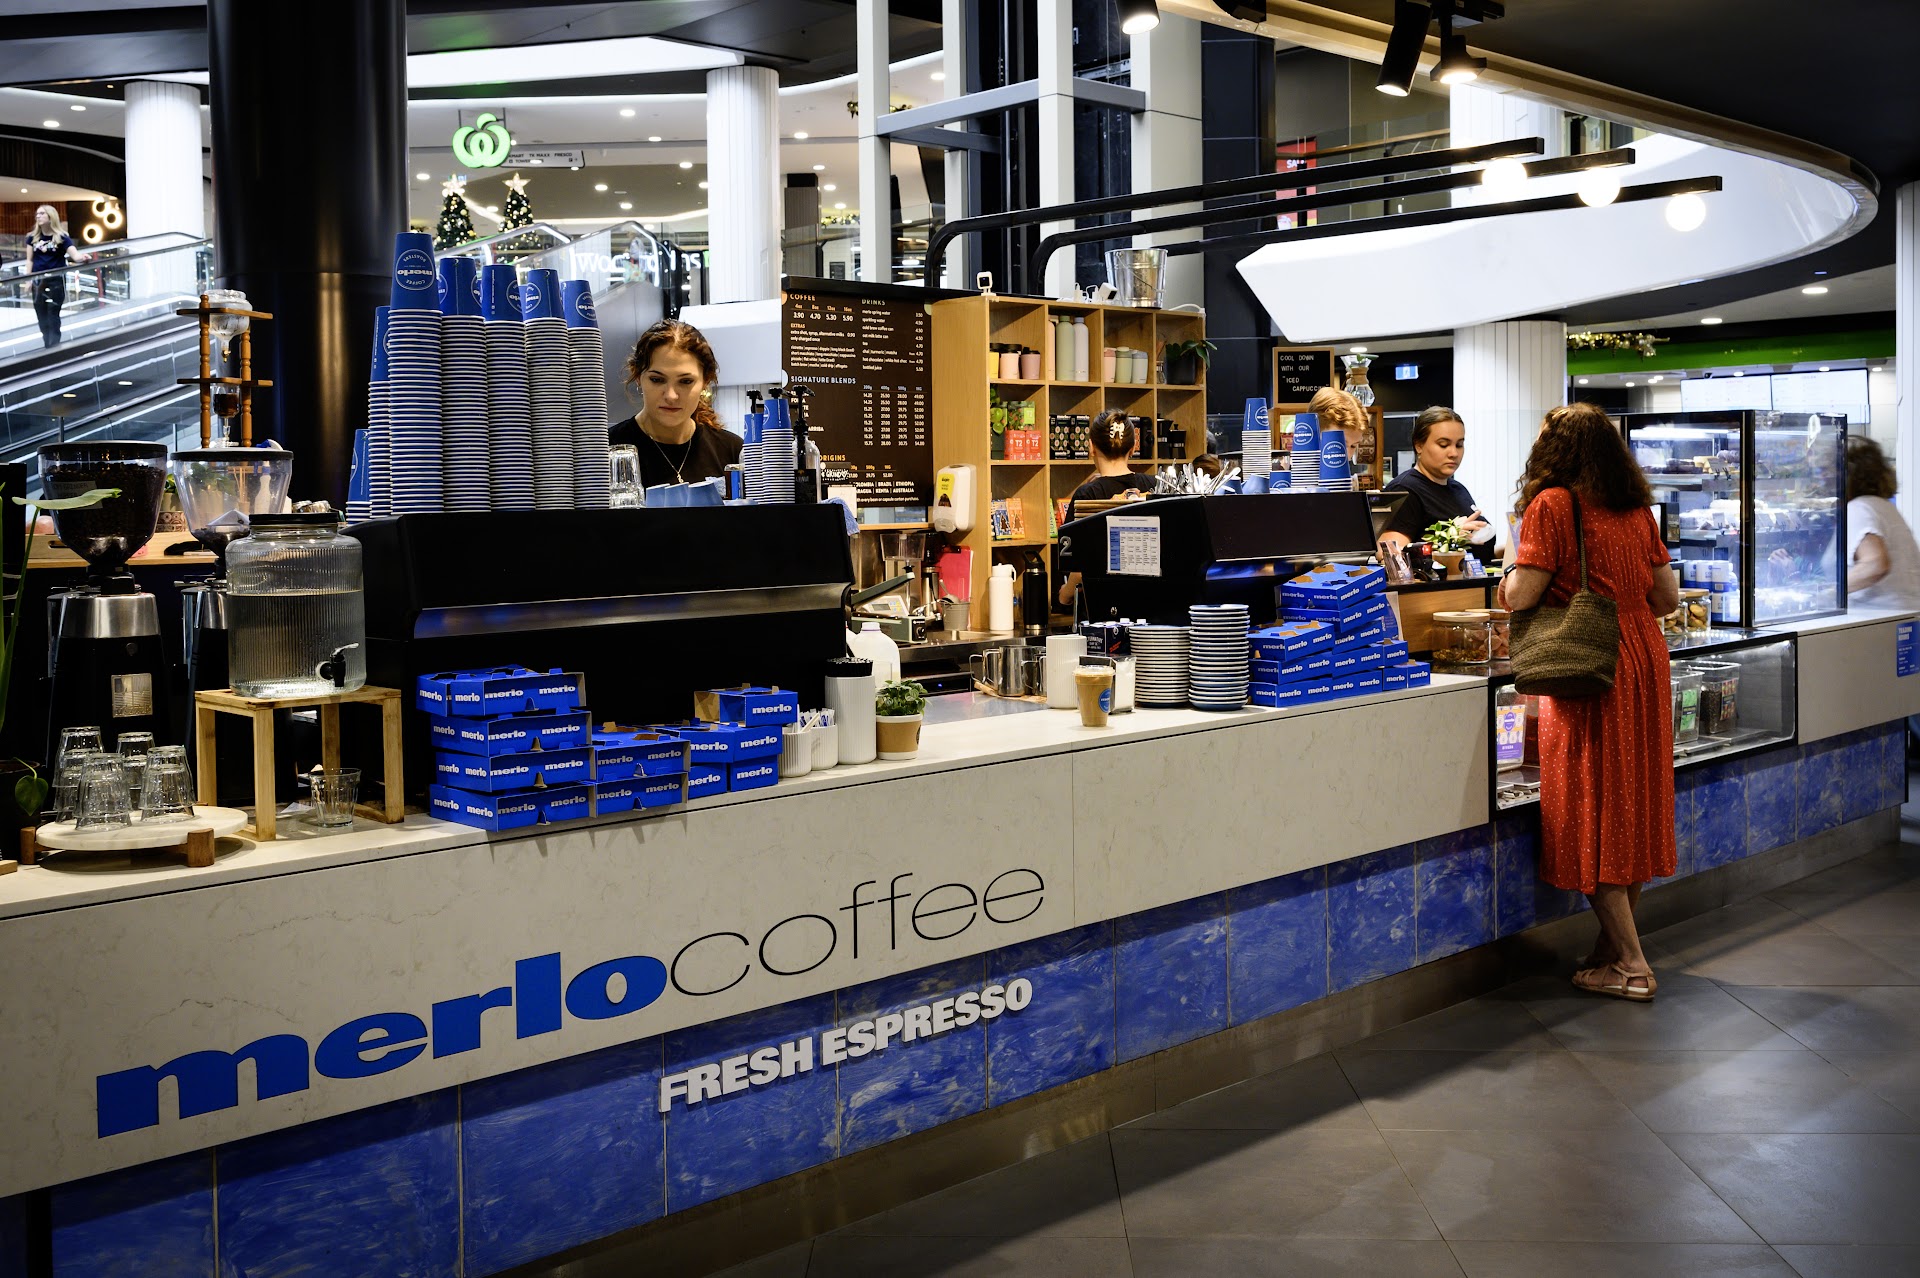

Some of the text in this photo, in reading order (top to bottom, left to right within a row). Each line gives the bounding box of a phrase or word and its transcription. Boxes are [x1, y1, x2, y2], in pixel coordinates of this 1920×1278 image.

[1060, 536, 1072, 556] 2
[1341, 576, 1383, 600] merlo merlo
[1343, 602, 1385, 623] merlo merlo
[1288, 633, 1332, 651] merlo merlo
[1334, 627, 1380, 644] merlo merlo
[1335, 652, 1381, 668] merlo merlo
[1387, 649, 1406, 659] merlo
[1282, 659, 1330, 674] merlo merlo
[1386, 674, 1405, 682] merlo
[1410, 670, 1428, 679] merlo
[484, 685, 576, 698] merlo merlo
[1279, 686, 1330, 698] merlo merlo
[1333, 678, 1380, 691] merlo merlo
[420, 689, 442, 701] merlo
[455, 693, 480, 702] merlo
[752, 704, 792, 714] merlo
[433, 725, 484, 741] merlo merlo
[488, 724, 580, 740] merlo merlo
[740, 735, 778, 748] merlo
[598, 750, 682, 765] merlo merlo
[438, 764, 487, 777] merlo merlo
[490, 759, 584, 776] merlo merlo
[736, 766, 773, 780] merlo
[596, 782, 680, 799] merlo merlo
[434, 798, 494, 818] merlo merlo
[498, 796, 586, 814] merlo merlo
[96, 868, 1045, 1139] merlo coffee
[659, 978, 1033, 1113] FRESH ESPRESSO
